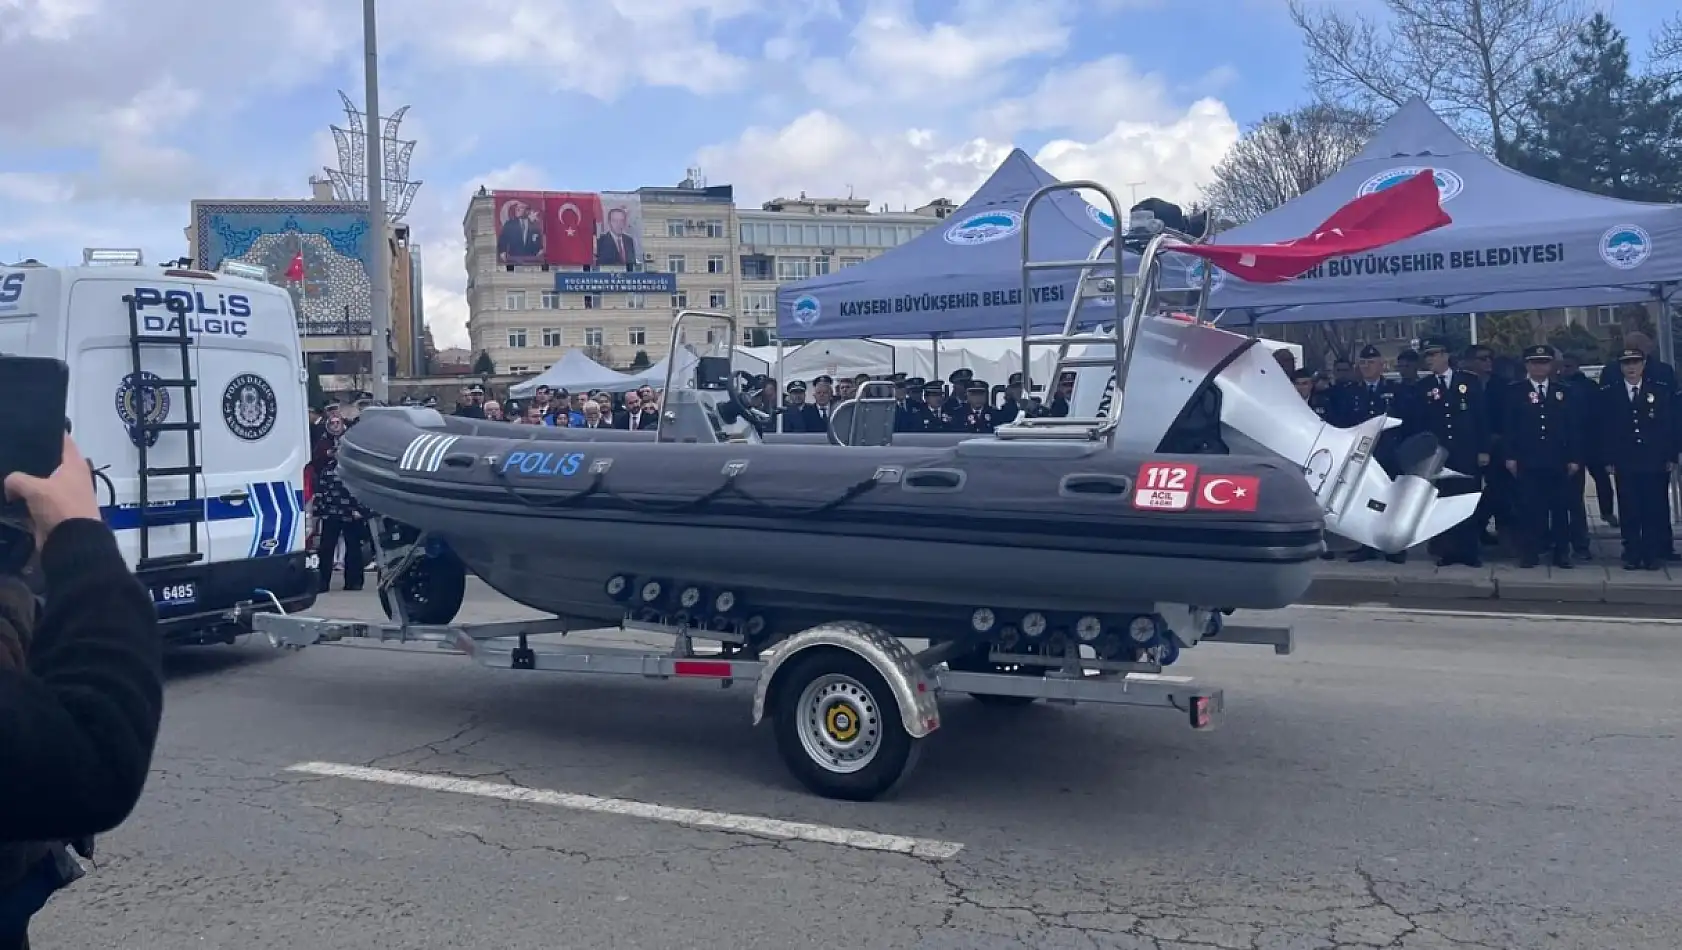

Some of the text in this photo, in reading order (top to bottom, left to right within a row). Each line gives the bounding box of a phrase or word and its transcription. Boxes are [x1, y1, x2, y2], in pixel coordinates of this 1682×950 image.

[1329, 252, 1444, 276] BÜYÜKŞEHİR
[1450, 242, 1563, 269] BELEDİYESİ
[840, 299, 892, 316] KAYSERİ
[895, 292, 978, 313] BÜYÜKŞEHİR
[143, 316, 248, 338] DALGIÇ
[501, 452, 585, 476] POLİS
[1147, 467, 1187, 488] 112
[163, 584, 194, 600] 6485
